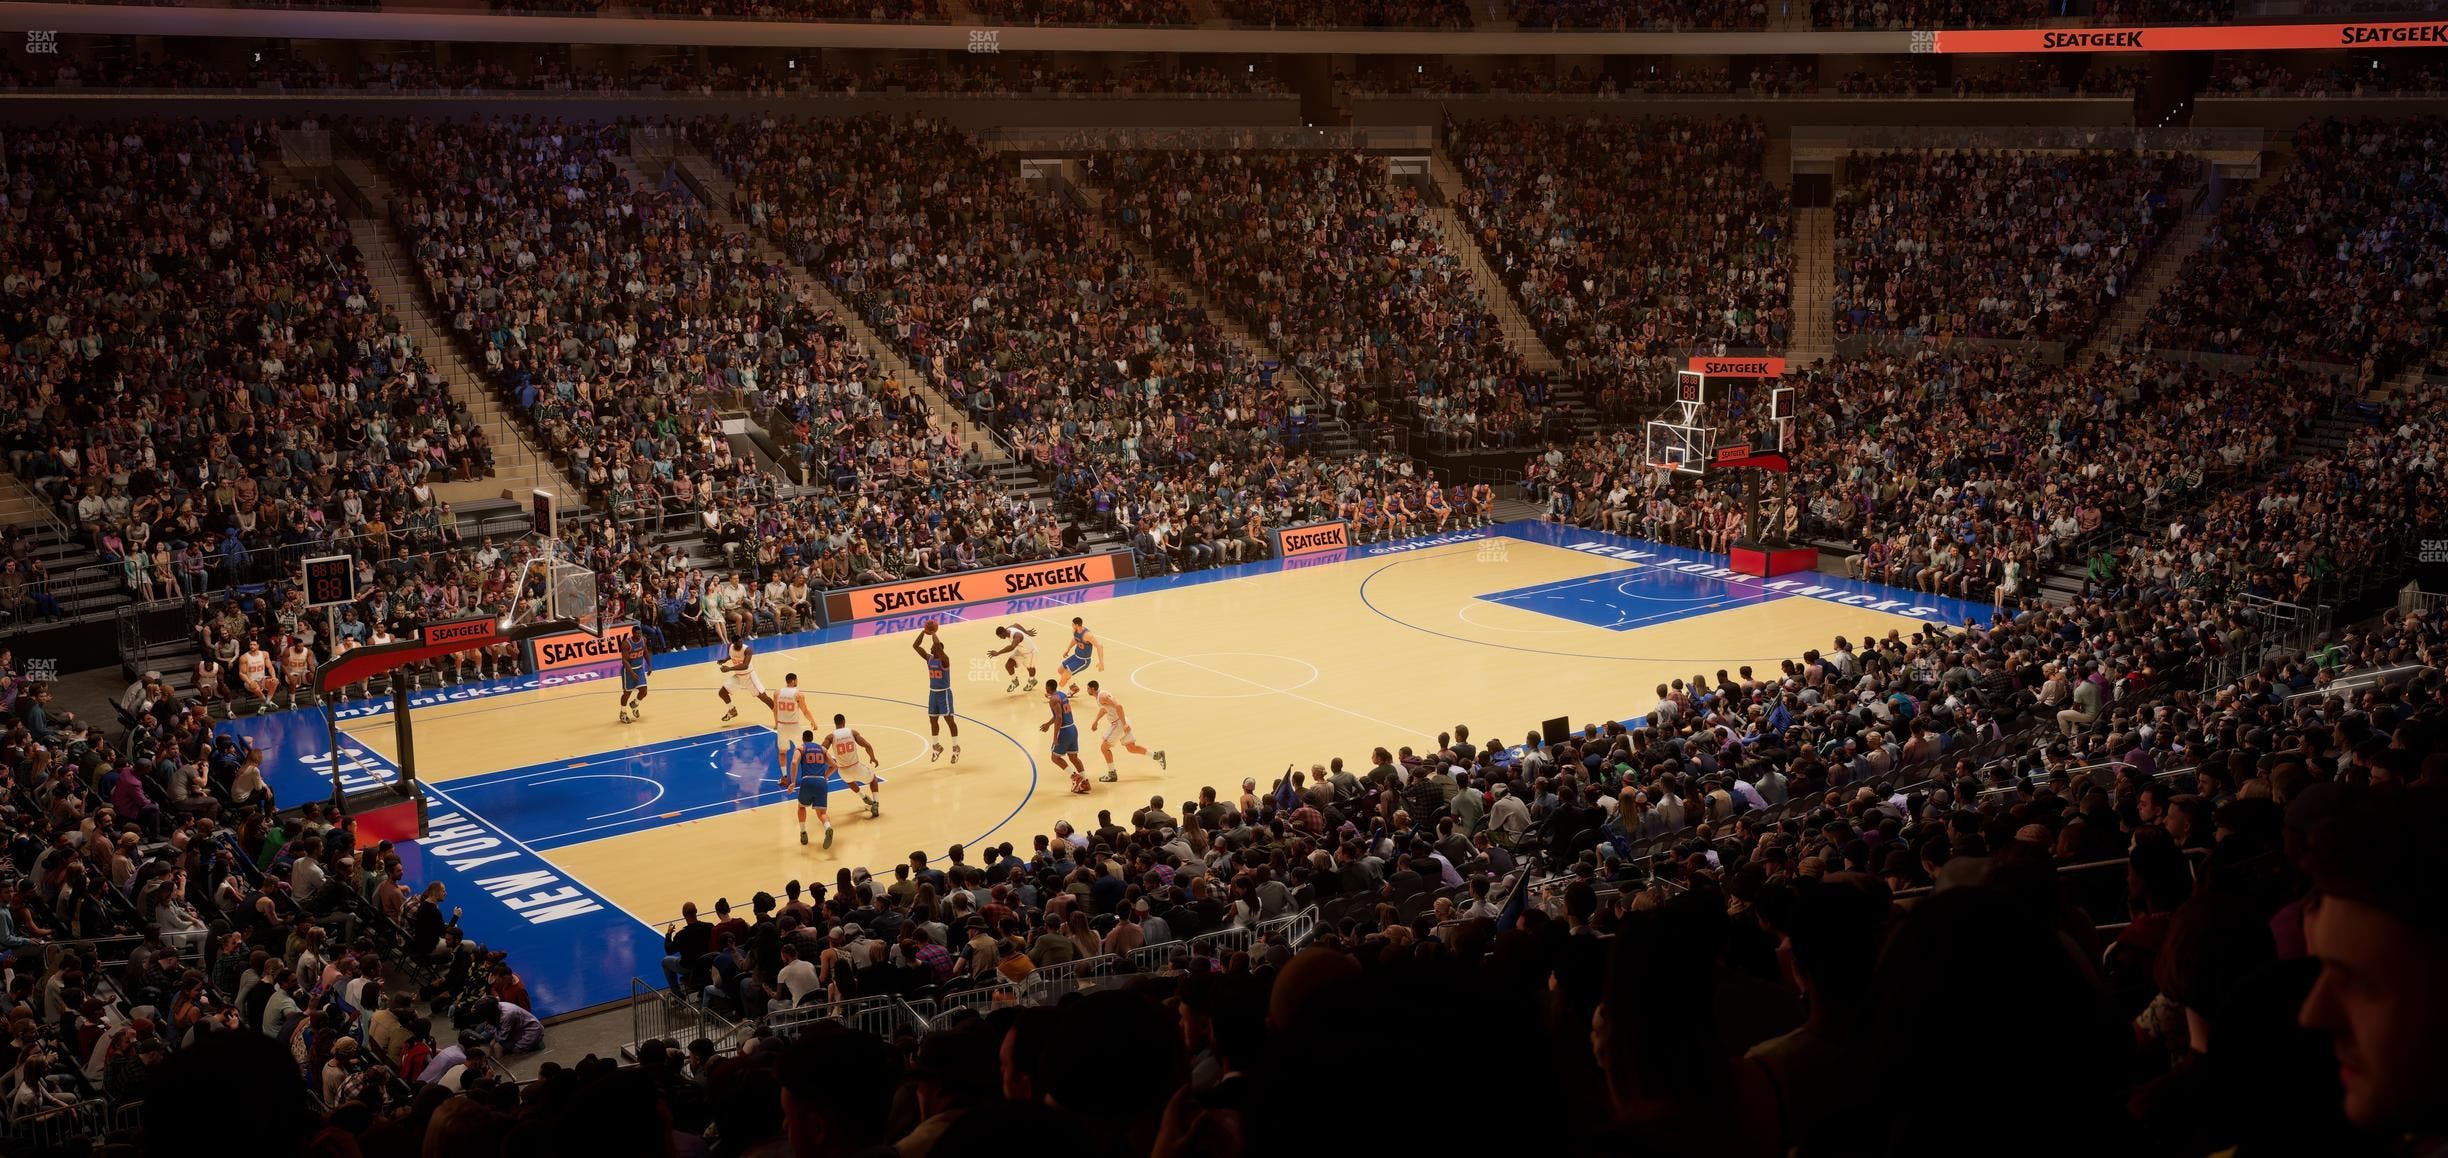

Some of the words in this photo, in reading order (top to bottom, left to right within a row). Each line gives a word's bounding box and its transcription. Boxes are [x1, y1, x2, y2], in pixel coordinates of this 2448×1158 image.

[2043, 31, 2144, 48] SEATGEEK
[2342, 25, 2448, 44] SEATGEEK
[1705, 362, 1769, 374] SEATGEEK
[1286, 527, 1344, 552] SEATGEEK
[1369, 533, 1486, 555] @nyknicks
[873, 581, 965, 613] SEATGEEK
[1004, 562, 1089, 594] SEATGEEK
[1565, 541, 1658, 560] NEW
[1655, 558, 1761, 583] YORK
[1762, 580, 1938, 616] KNICKS
[432, 622, 490, 642] SEATGEEK
[779, 701, 796, 712] 00
[805, 753, 825, 764] 00
[836, 741, 855, 756] 00
[414, 811, 522, 873] YORK
[473, 869, 604, 925] NEW
